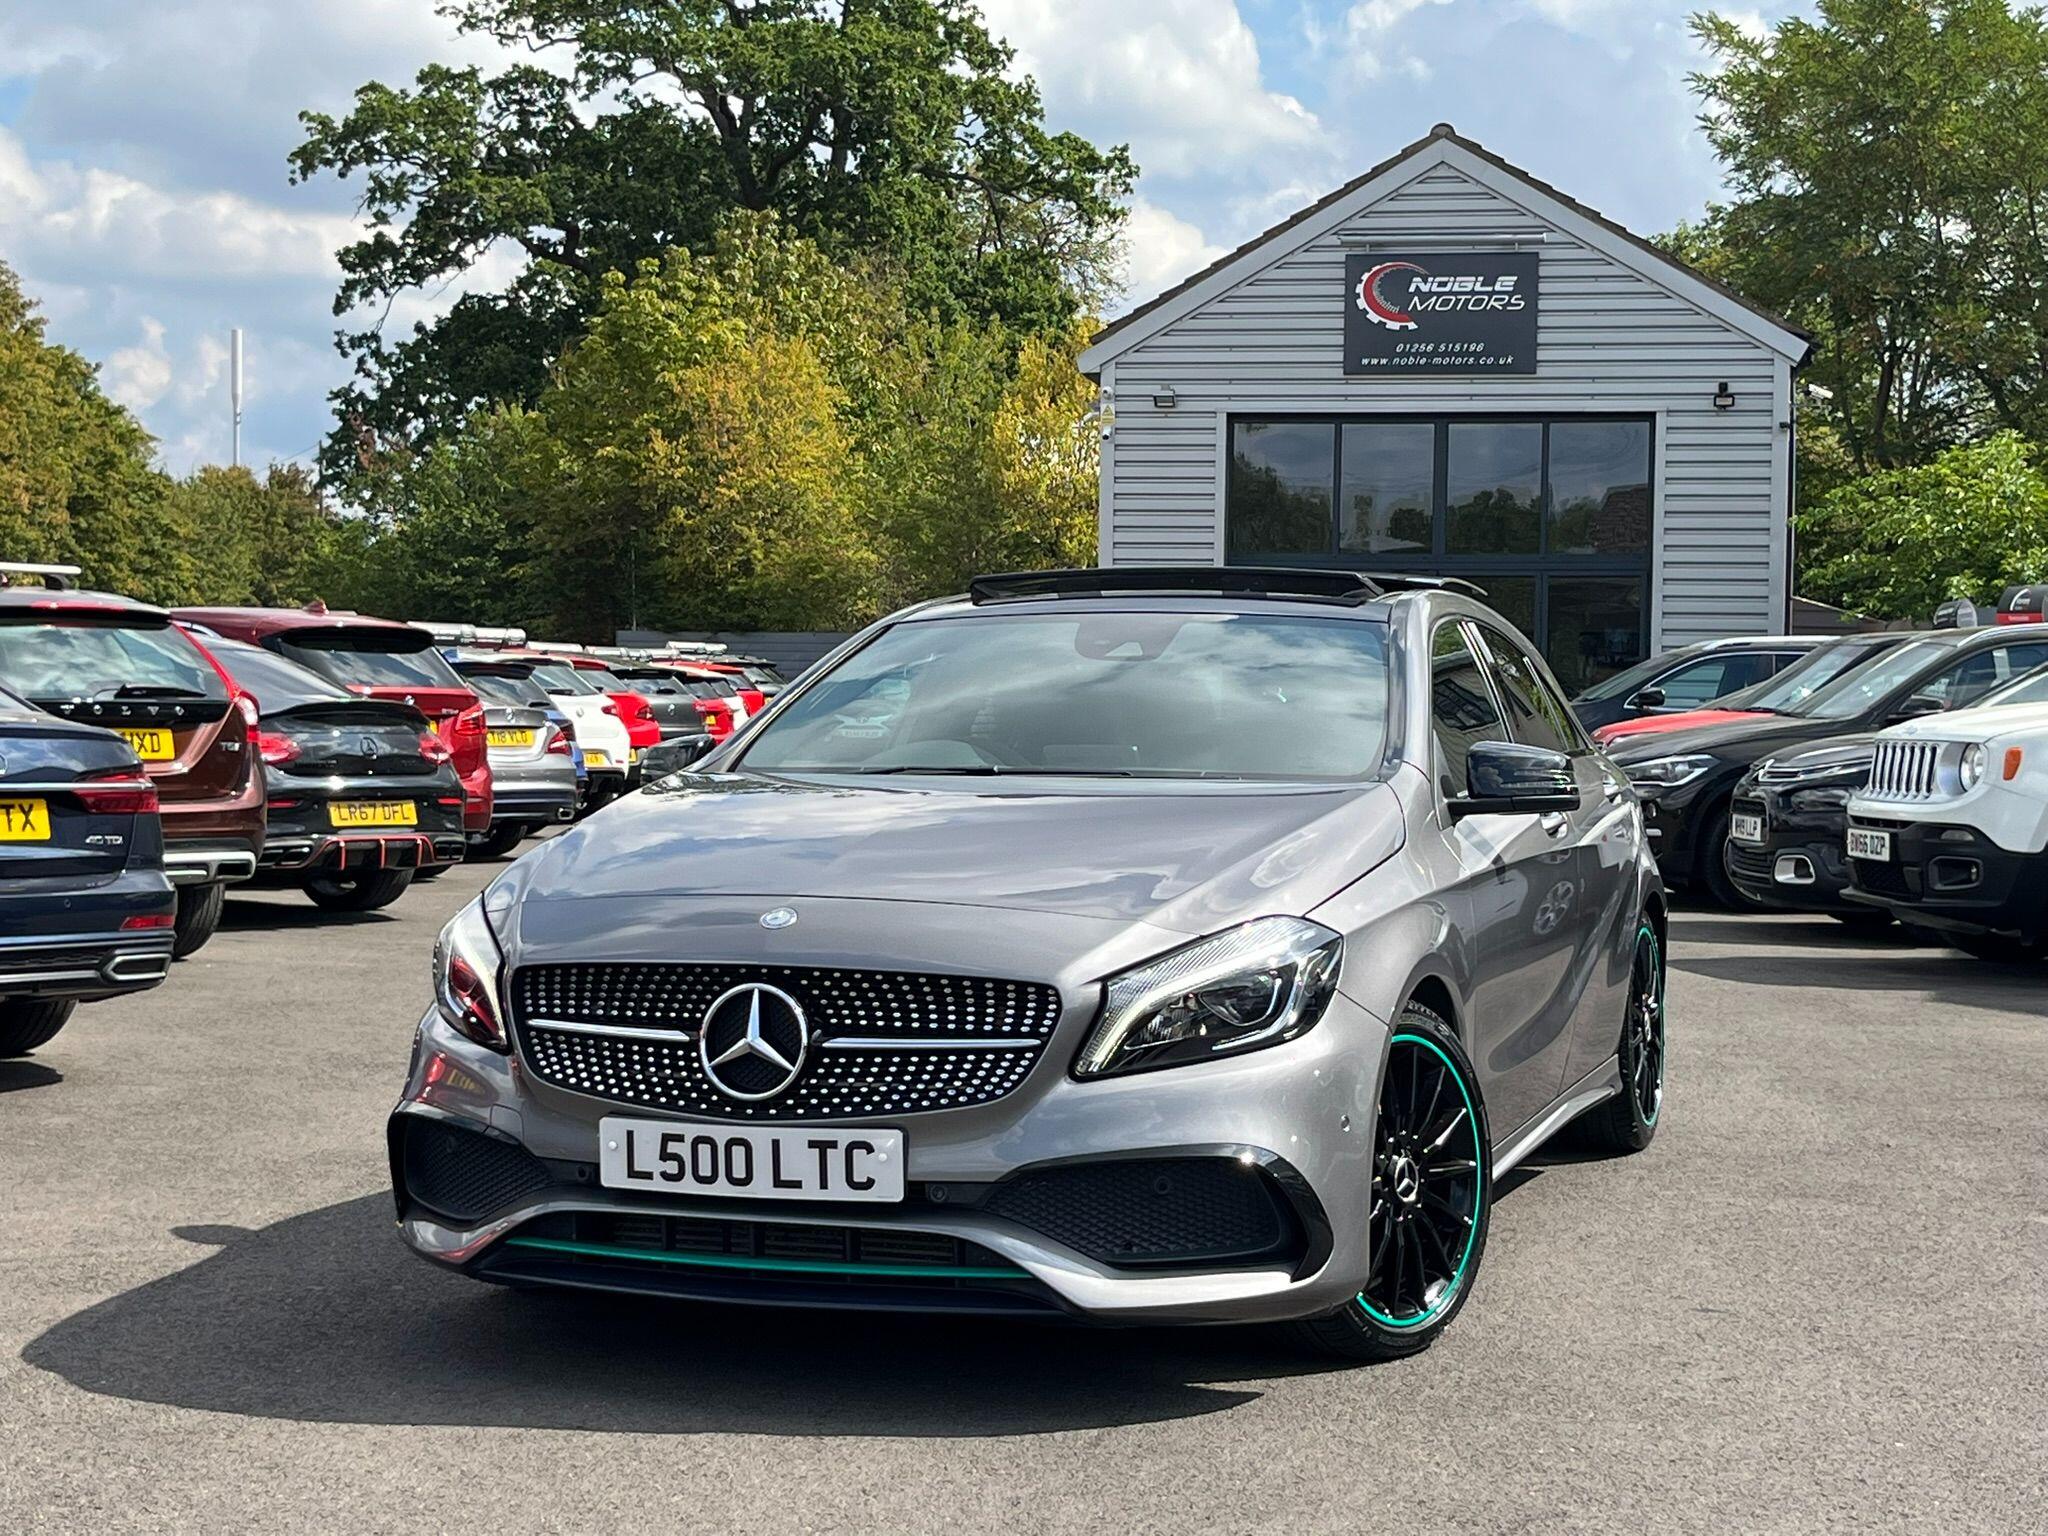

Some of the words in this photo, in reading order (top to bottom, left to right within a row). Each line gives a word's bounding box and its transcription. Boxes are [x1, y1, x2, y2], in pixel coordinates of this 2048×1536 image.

[1408, 276, 1518, 293] NOBLE
[1408, 294, 1525, 311] MOTORS
[337, 803, 376, 821] LR67
[382, 802, 410, 820] DFL
[626, 1130, 754, 1187] L500
[771, 1138, 876, 1191] LTC
